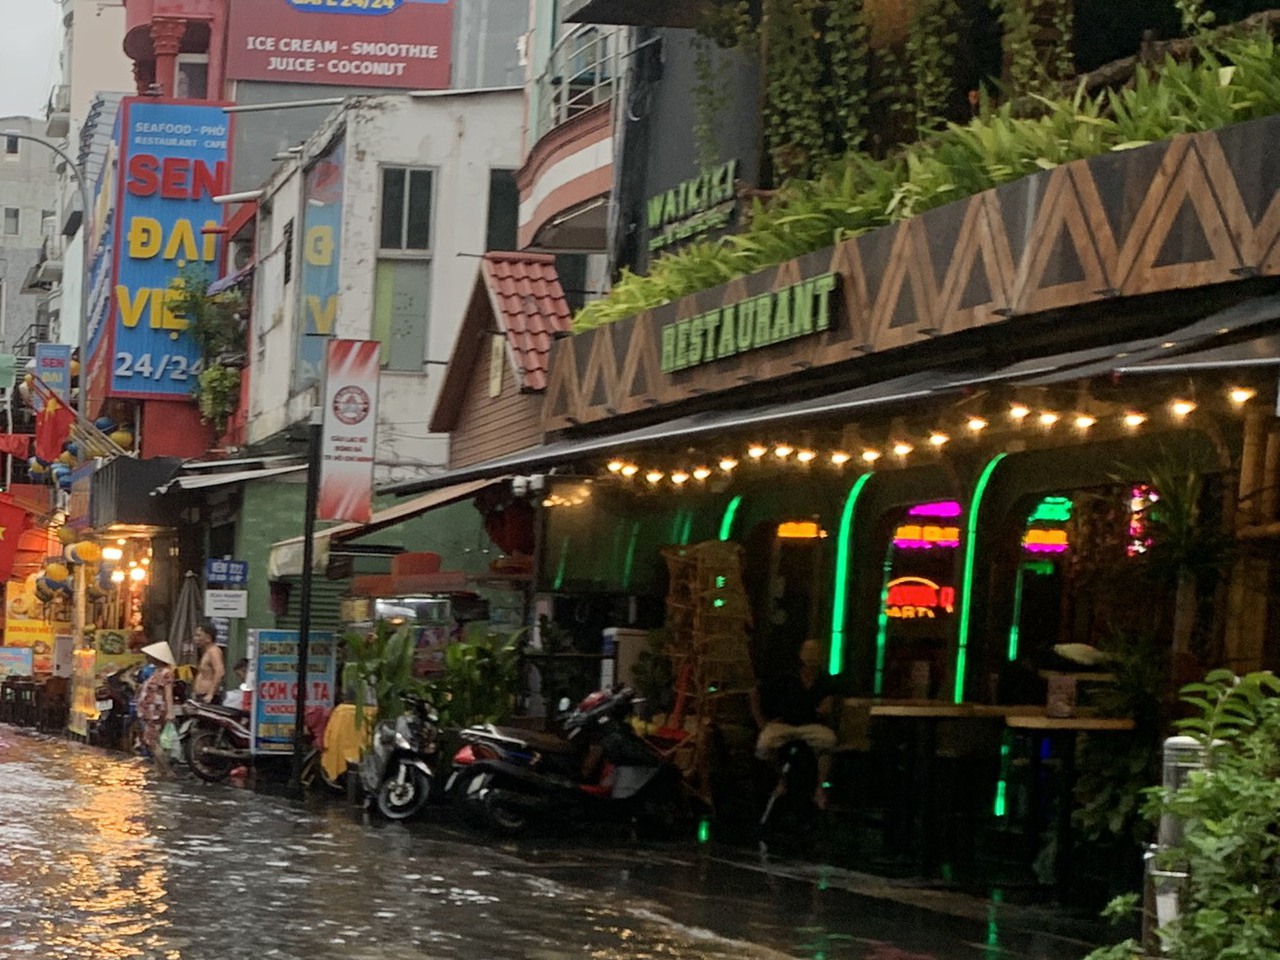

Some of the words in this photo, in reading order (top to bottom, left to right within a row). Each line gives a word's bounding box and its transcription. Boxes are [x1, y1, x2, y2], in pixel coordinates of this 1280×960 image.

[246, 36, 275, 50] ICE
[279, 38, 337, 54] CREAM
[351, 41, 439, 59] SMOOTHIE
[267, 57, 315, 72] JUICE
[327, 59, 406, 76] COCONUT
[134, 137, 197, 147] RESTAURANT
[135, 122, 192, 134] SEAFOOD
[127, 153, 226, 201] SEN
[127, 216, 217, 268] ĐẠI
[115, 277, 220, 340] VIỆ
[661, 271, 836, 374] RESTAURANT
